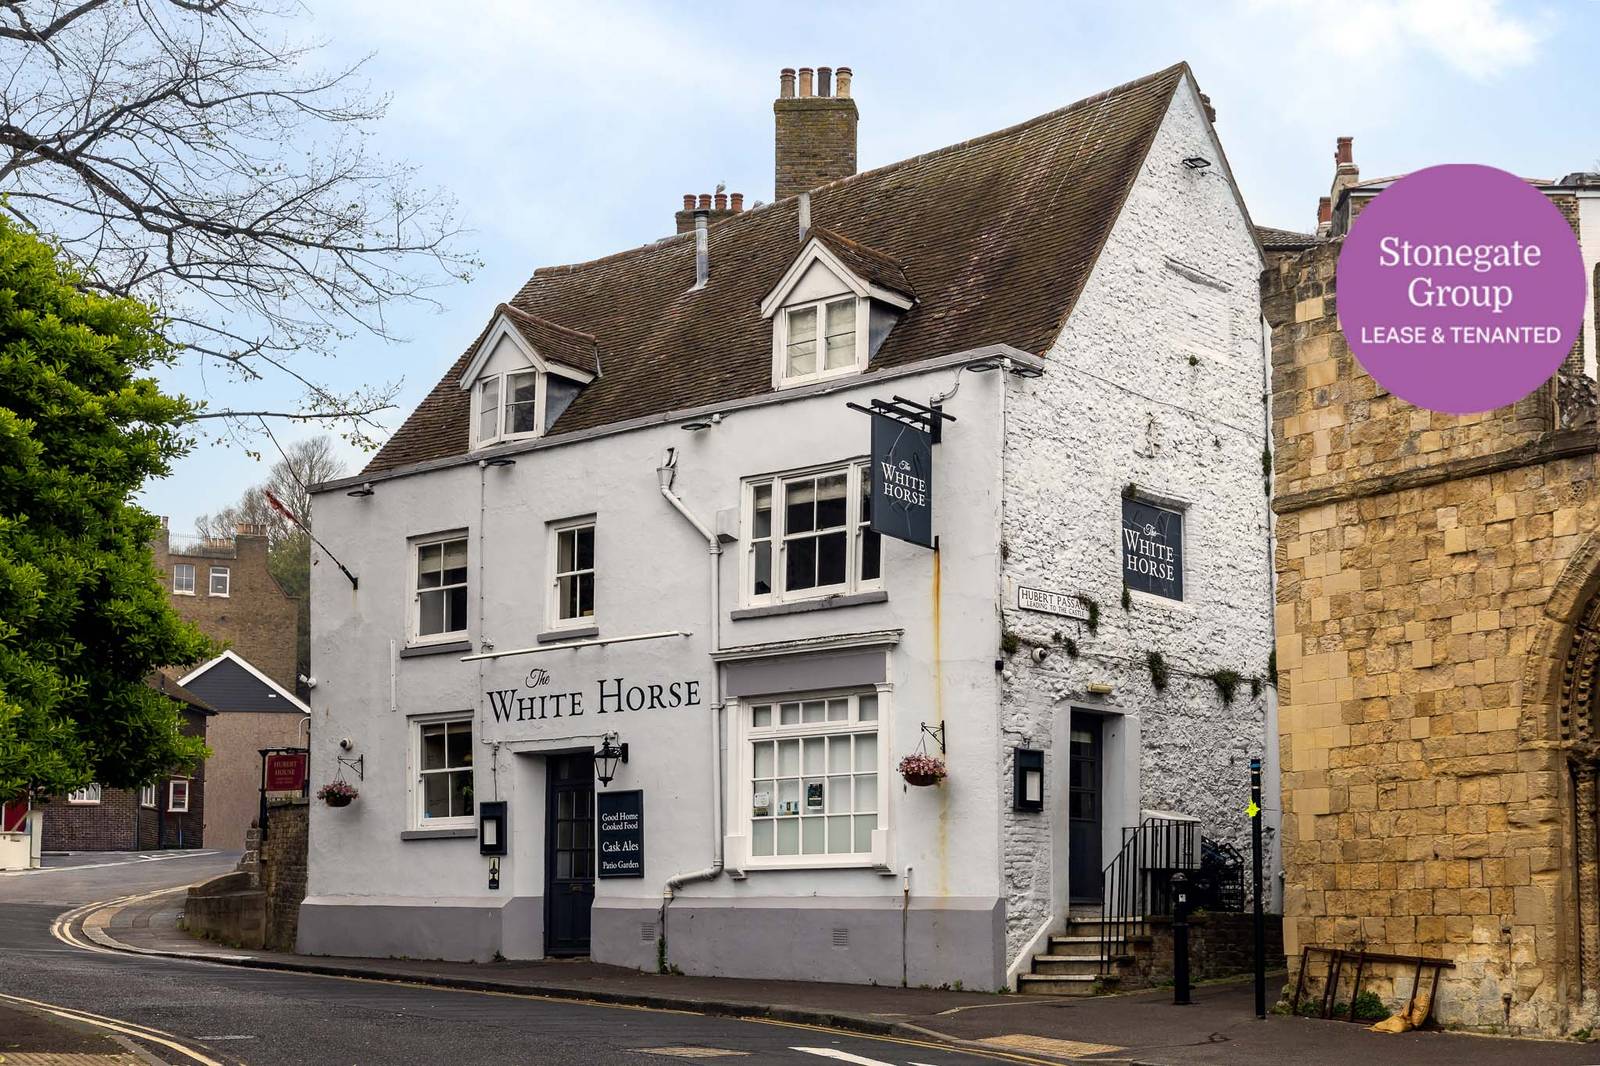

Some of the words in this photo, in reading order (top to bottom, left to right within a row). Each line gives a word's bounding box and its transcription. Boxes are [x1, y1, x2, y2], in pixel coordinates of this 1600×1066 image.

[898, 460, 911, 471] The
[881, 461, 926, 492] WHITE
[883, 482, 926, 507] HORSE
[1143, 523, 1157, 537] The
[1123, 527, 1174, 563] WHITE
[1126, 553, 1175, 581] HORSE
[1021, 589, 1053, 604] HUBERT
[1026, 600, 1048, 610] LEADING
[1050, 604, 1057, 612] TO
[1058, 606, 1067, 614] THE
[1069, 608, 1085, 618] CASTLE
[525, 668, 551, 689] The
[486, 688, 584, 724] WHITE
[597, 677, 701, 715] HORSE
[602, 812, 619, 821] Good
[620, 812, 638, 821] Home
[602, 821, 624, 831] Cooked
[624, 821, 639, 830] Food
[602, 840, 621, 853] Cask
[622, 840, 639, 852] Ales
[602, 861, 617, 870] Patio
[618, 860, 639, 869] Garden
